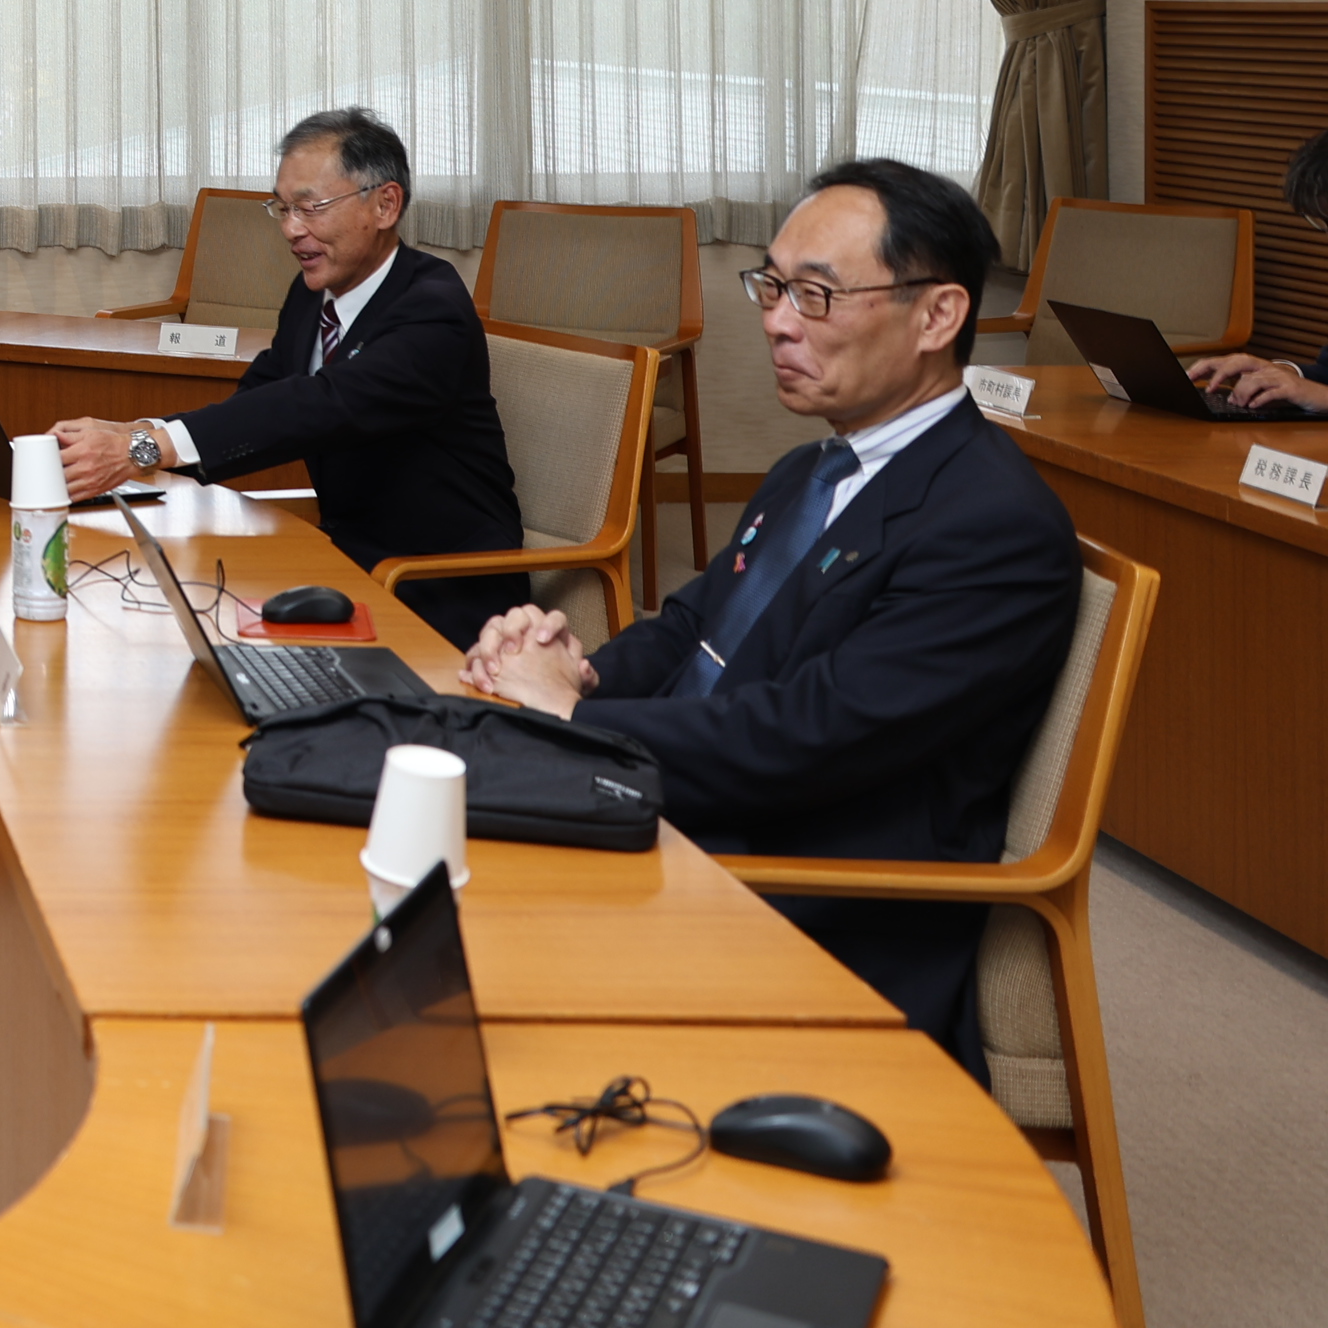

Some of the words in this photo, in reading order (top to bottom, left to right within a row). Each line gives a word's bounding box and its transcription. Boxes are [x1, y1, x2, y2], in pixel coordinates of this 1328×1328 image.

[169, 332, 226, 347] 報道
[1255, 459, 1312, 490] 税務課長
